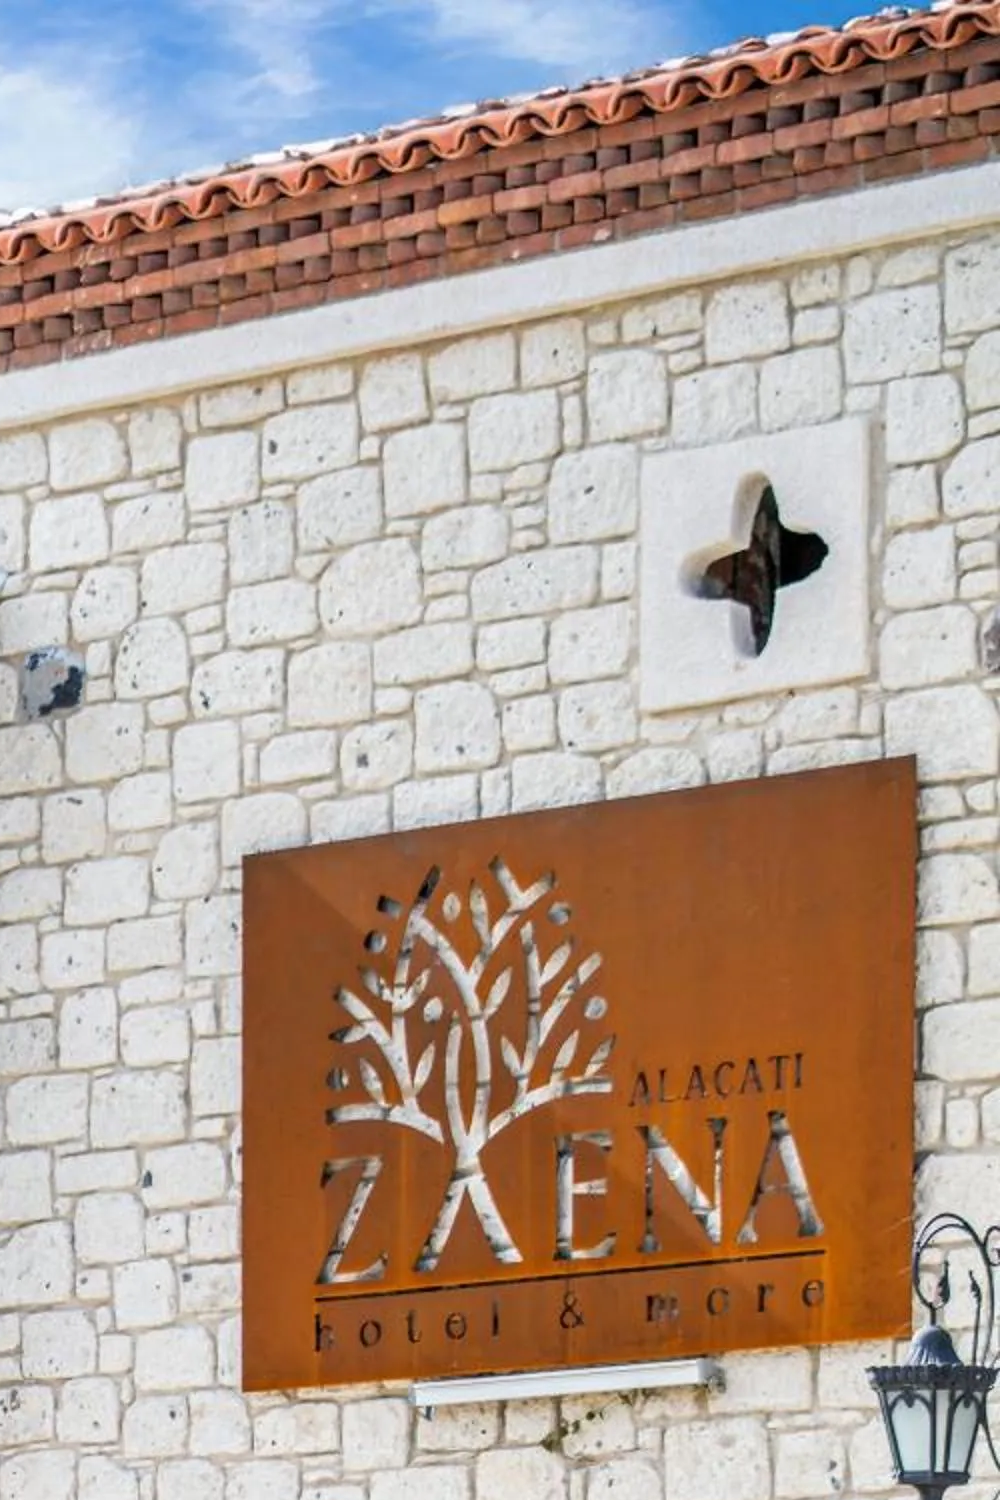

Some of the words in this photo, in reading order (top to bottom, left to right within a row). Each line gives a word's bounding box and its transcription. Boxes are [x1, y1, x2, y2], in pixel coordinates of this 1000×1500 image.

[315, 1302, 499, 1353] hotel
[559, 1290, 584, 1329] &
[646, 1279, 825, 1322] more
